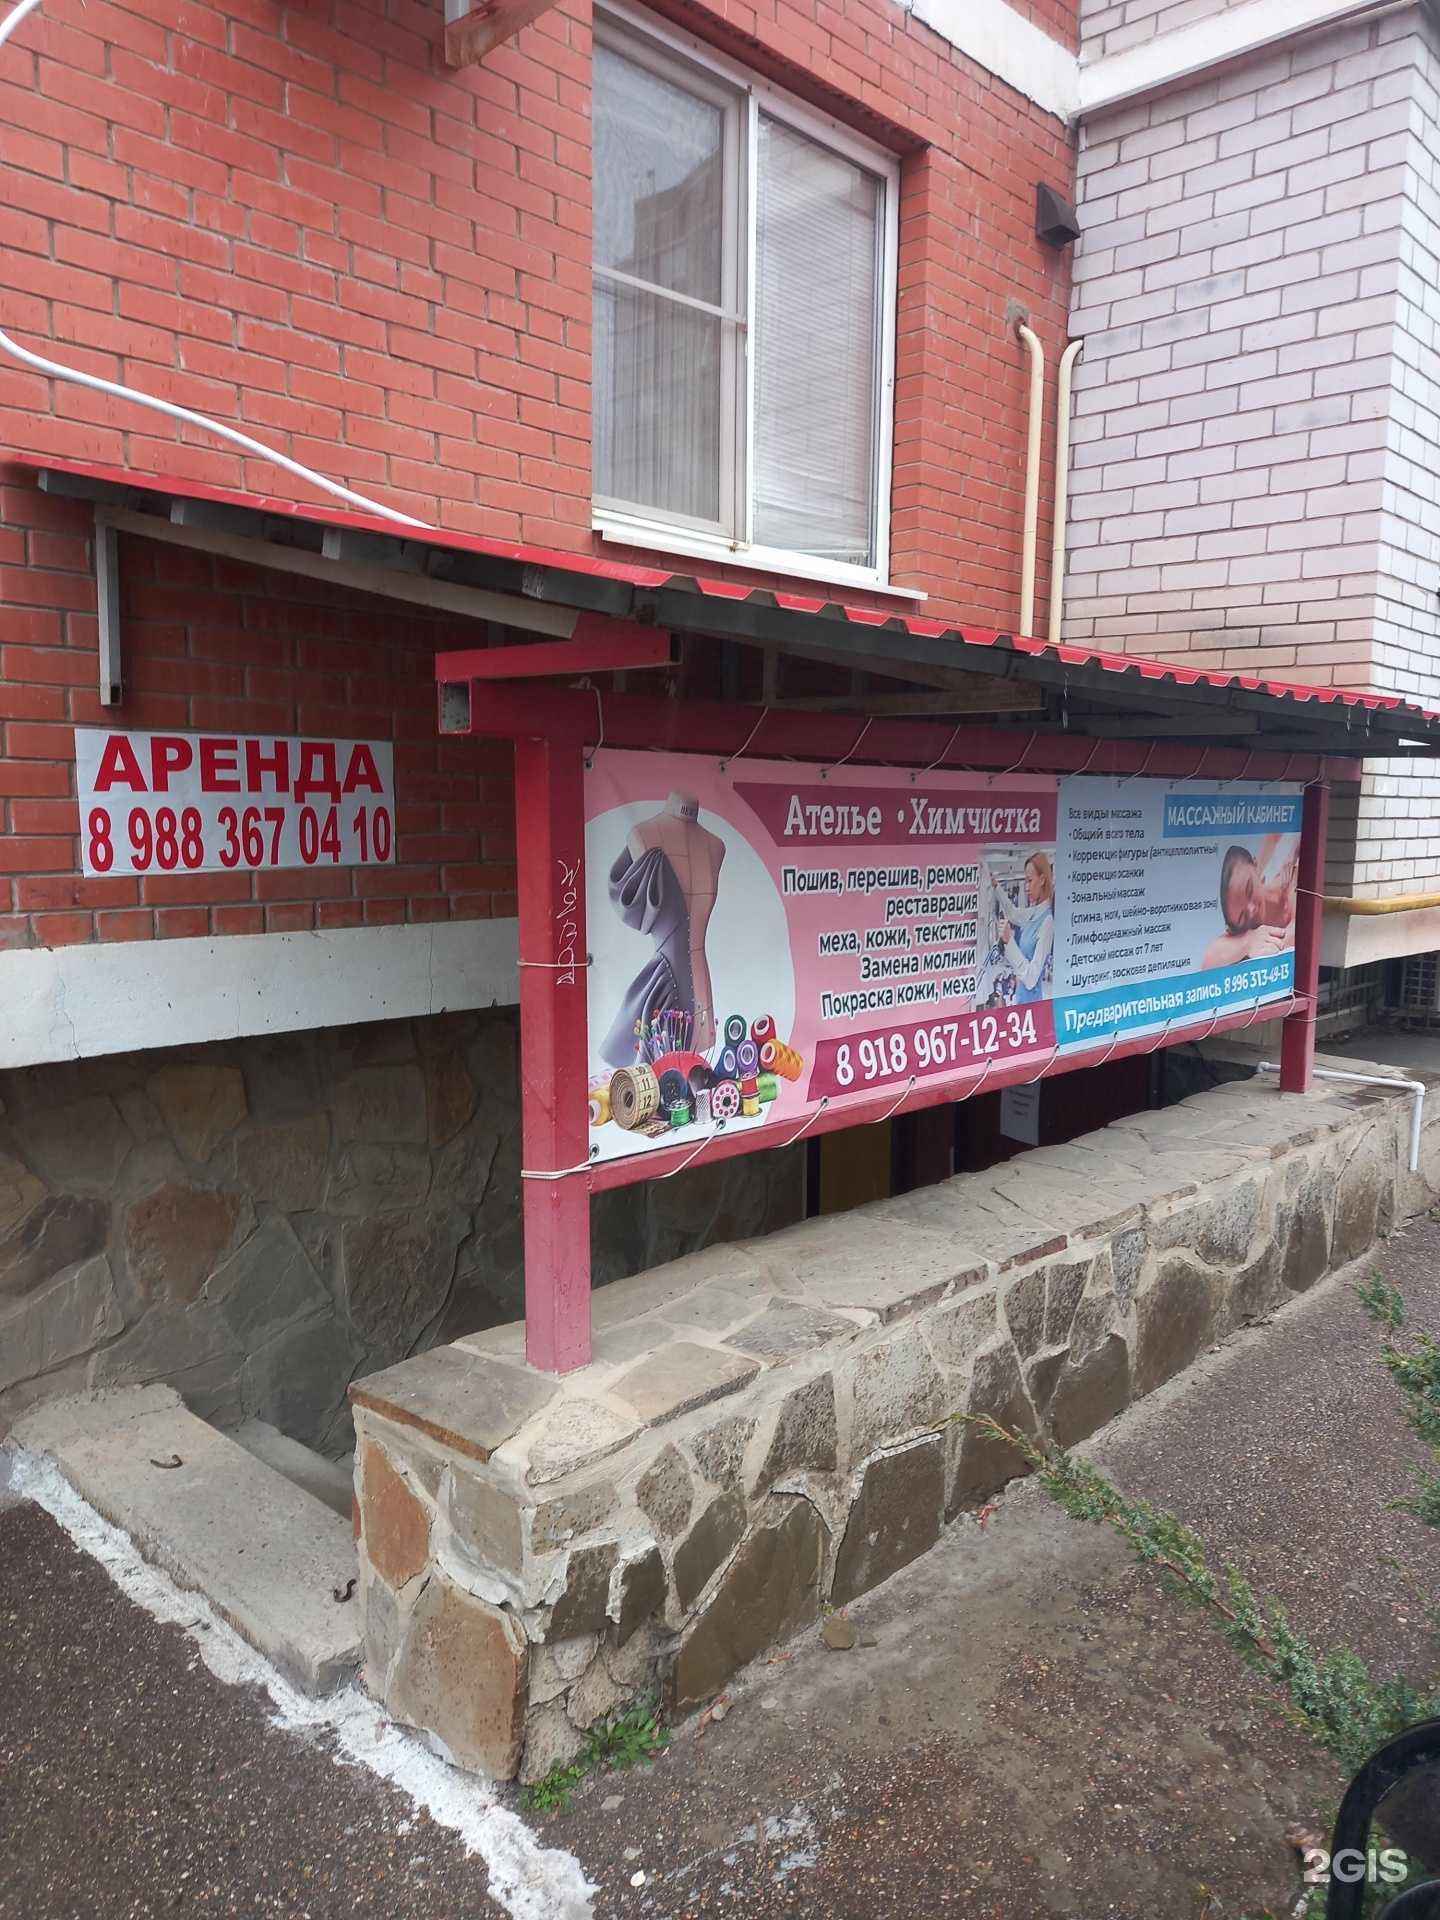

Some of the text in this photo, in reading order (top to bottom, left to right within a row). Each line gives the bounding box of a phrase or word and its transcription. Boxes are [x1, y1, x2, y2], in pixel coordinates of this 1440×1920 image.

[93, 735, 384, 804] АРЕНДА
[784, 795, 1041, 836] Ателье Химчистка
[1068, 807, 1081, 819] Все
[1083, 809, 1110, 820] виды
[1168, 801, 1296, 826] МАССАЖНЫЙ КАБИНЕТ
[88, 806, 391, 872] 8 988 367 04 10
[1073, 827, 1104, 841] Общий
[1125, 829, 1145, 840] тела
[1072, 849, 1118, 863] Коррекция
[783, 863, 979, 893] Пошив, перешив, ремонт,
[1072, 870, 1117, 884] Коррекция
[886, 893, 978, 921] реставрация
[819, 921, 976, 954] меха, кожи, текстиля
[1144, 922, 1172, 935] массаж
[862, 948, 976, 980] Замена молнии
[1070, 949, 1107, 968] Детский
[1134, 944, 1144, 955] от
[1144, 942, 1150, 954] 7
[1150, 943, 1164, 953] лет
[1147, 957, 1191, 974] депиляция
[821, 975, 976, 1017] Покраска кожи, меха
[1064, 990, 1184, 1034] Предварительная
[1185, 983, 1222, 1004] запись
[1224, 976, 1231, 994] 8
[1231, 972, 1248, 993] 996
[835, 1009, 1038, 1087] 8 918 967-12-34
